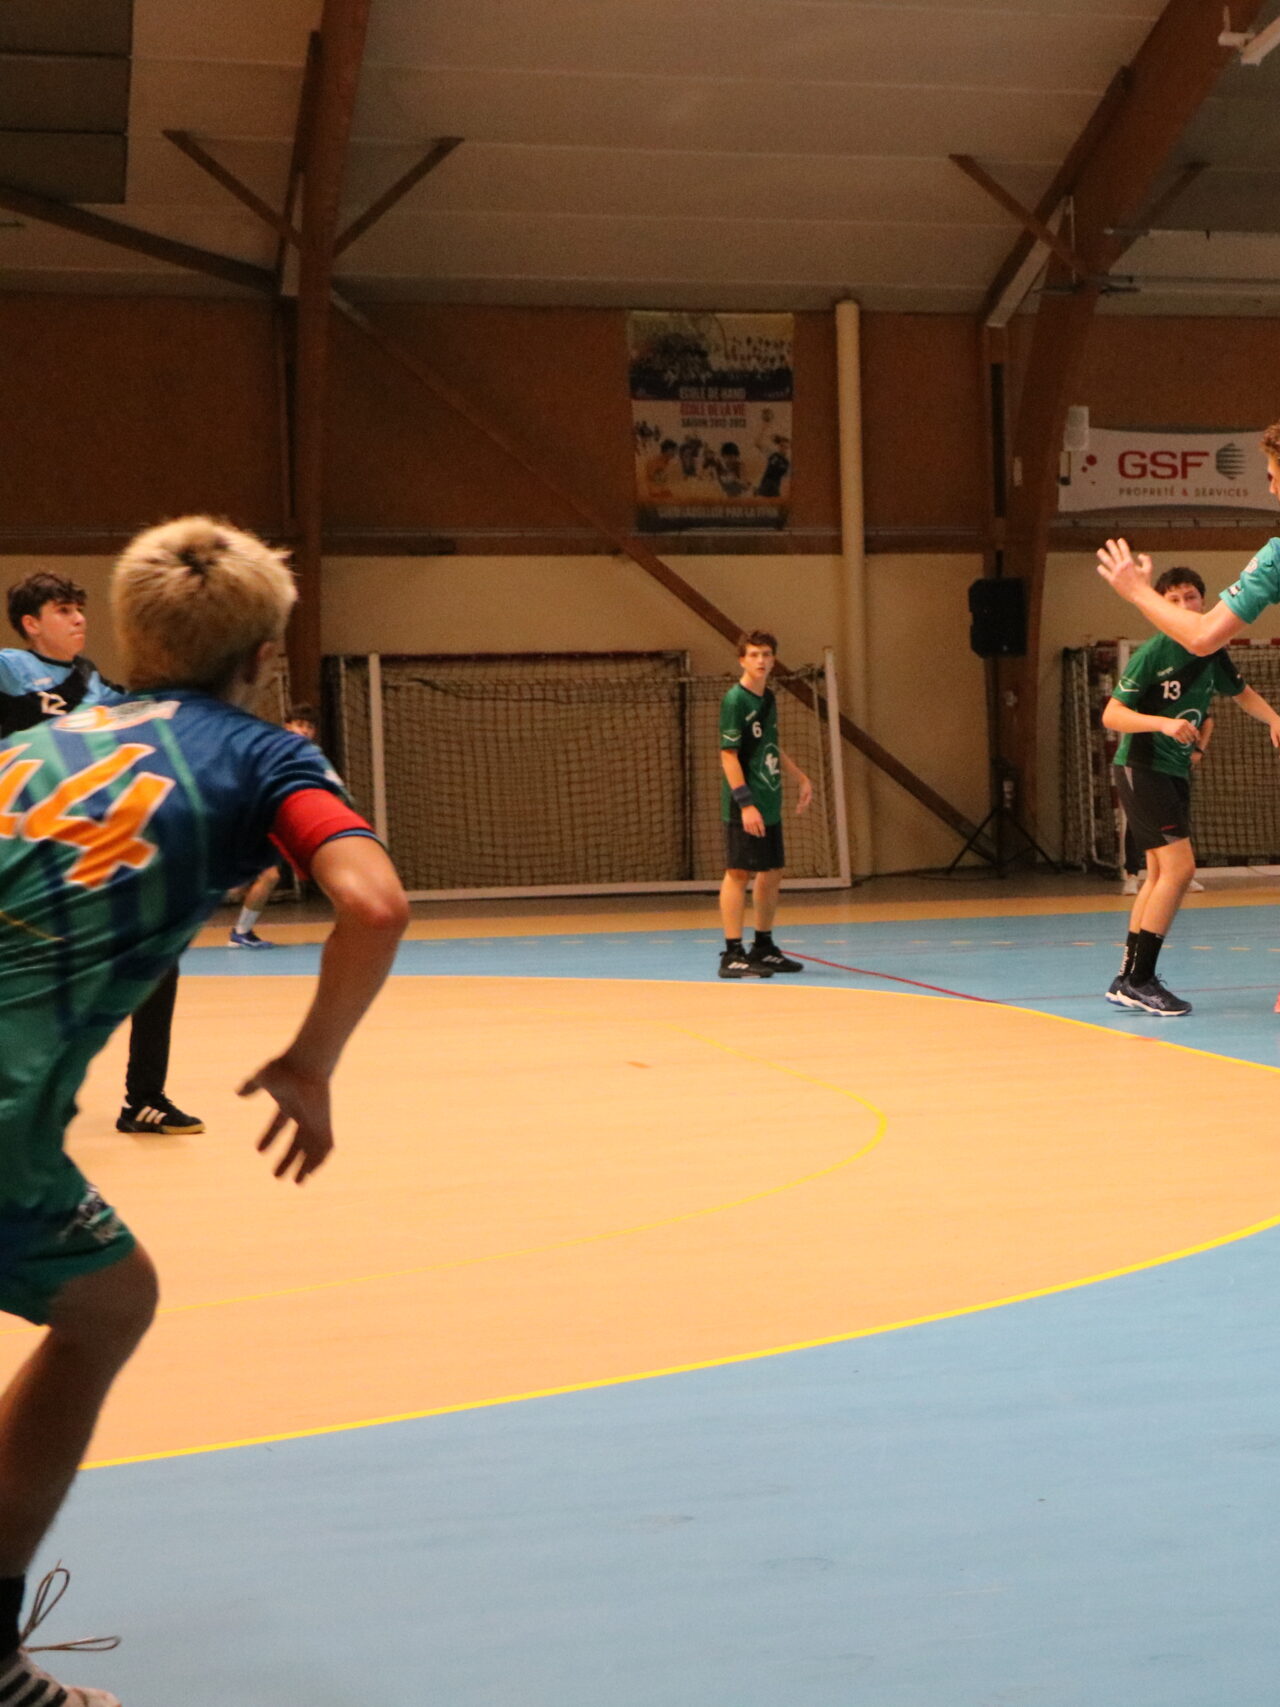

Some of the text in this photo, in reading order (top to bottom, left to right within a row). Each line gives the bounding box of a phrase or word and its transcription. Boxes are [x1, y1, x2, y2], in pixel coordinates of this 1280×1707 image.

[1118, 450, 1209, 480] GSF
[1119, 486, 1175, 497] PROPRETÉ
[1195, 487, 1249, 497] SERVICES
[1160, 680, 1182, 701] 13
[752, 721, 763, 739] 6
